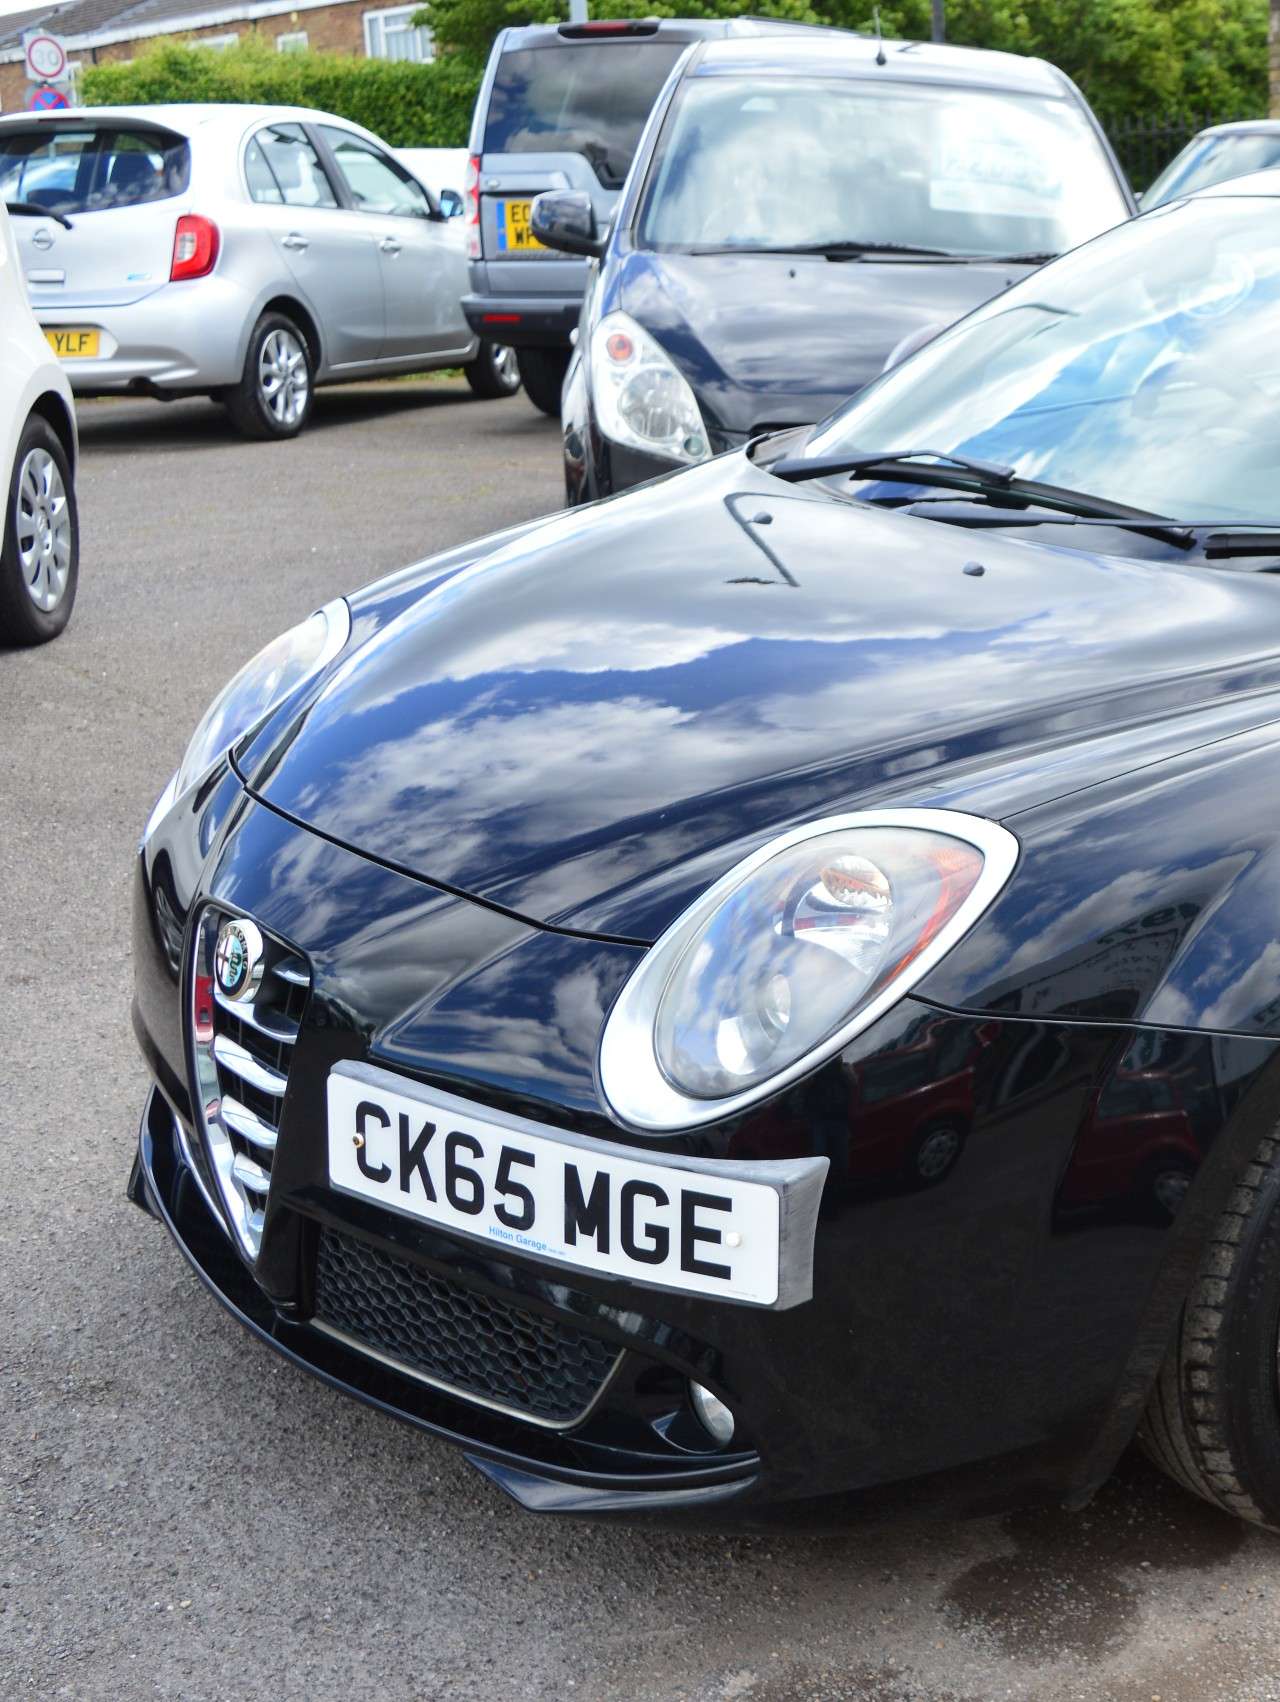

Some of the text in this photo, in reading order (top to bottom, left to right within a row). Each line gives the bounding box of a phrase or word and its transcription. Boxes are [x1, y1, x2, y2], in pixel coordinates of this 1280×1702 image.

[54, 332, 90, 352] YLF
[355, 1100, 734, 1281] CK65 MGE
[488, 1225, 548, 1251] Hilton Garage
